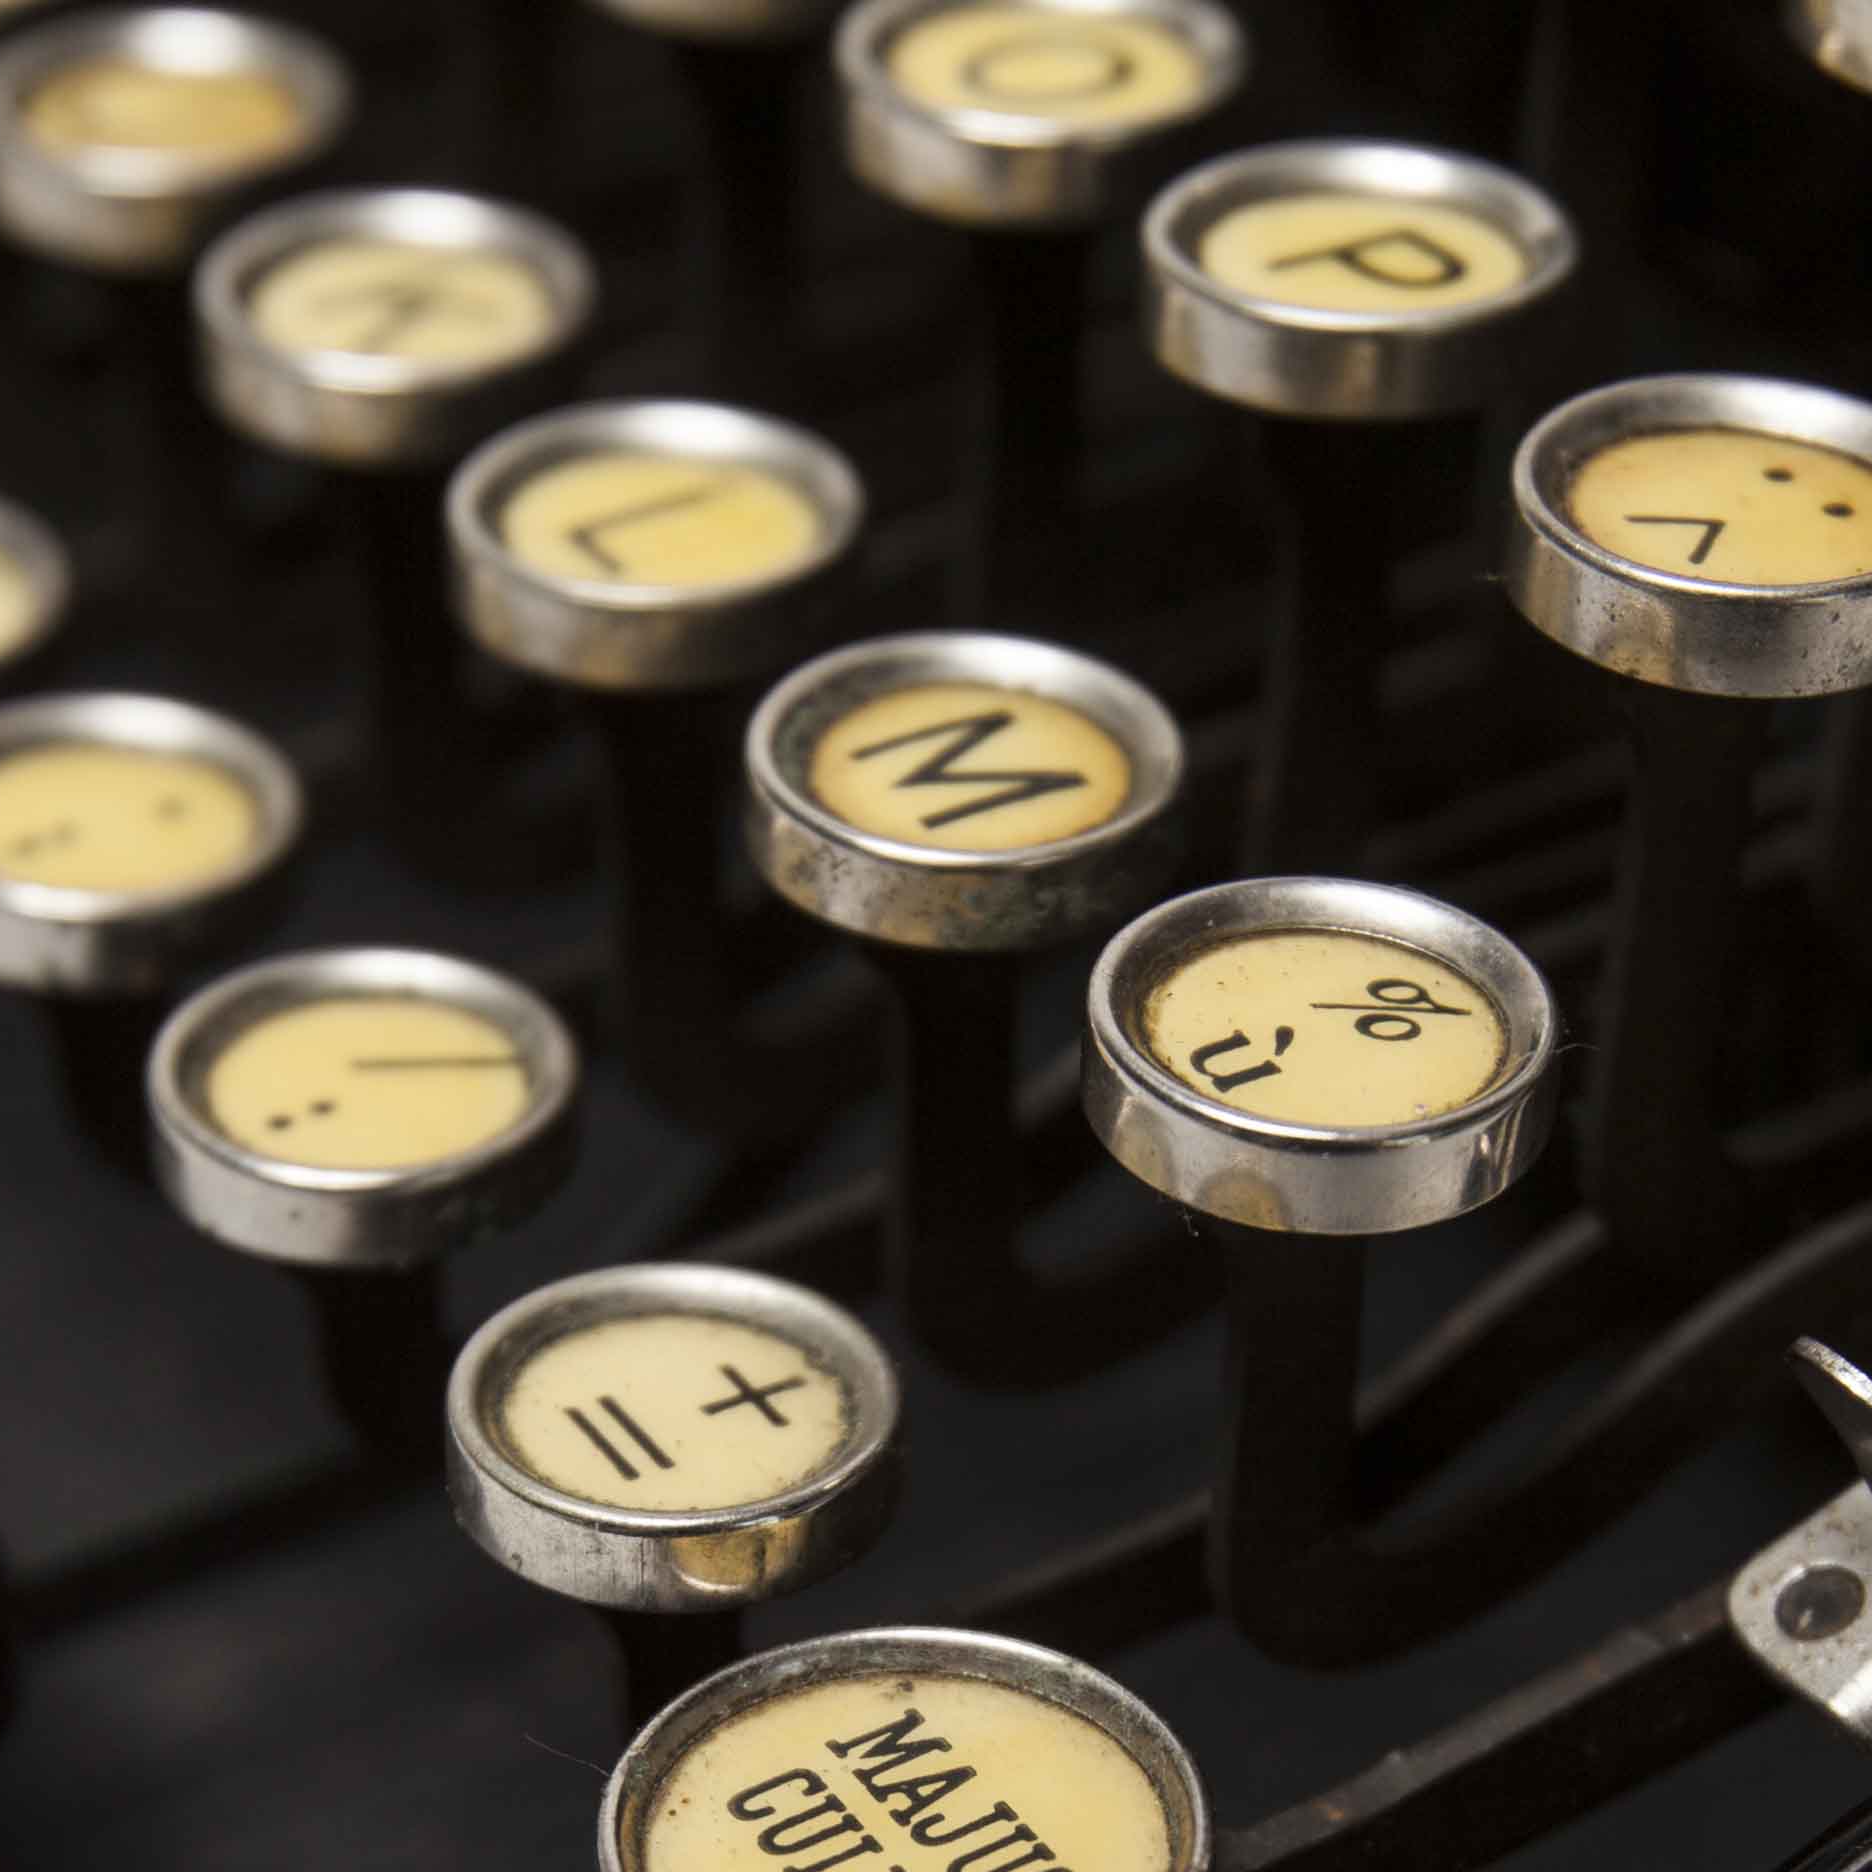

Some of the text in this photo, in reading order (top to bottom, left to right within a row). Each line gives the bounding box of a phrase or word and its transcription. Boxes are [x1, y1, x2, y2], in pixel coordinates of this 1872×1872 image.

[1266, 229, 1466, 290] P
[566, 478, 736, 576] L
[849, 709, 1090, 829] M
[1309, 978, 1473, 1041] %
